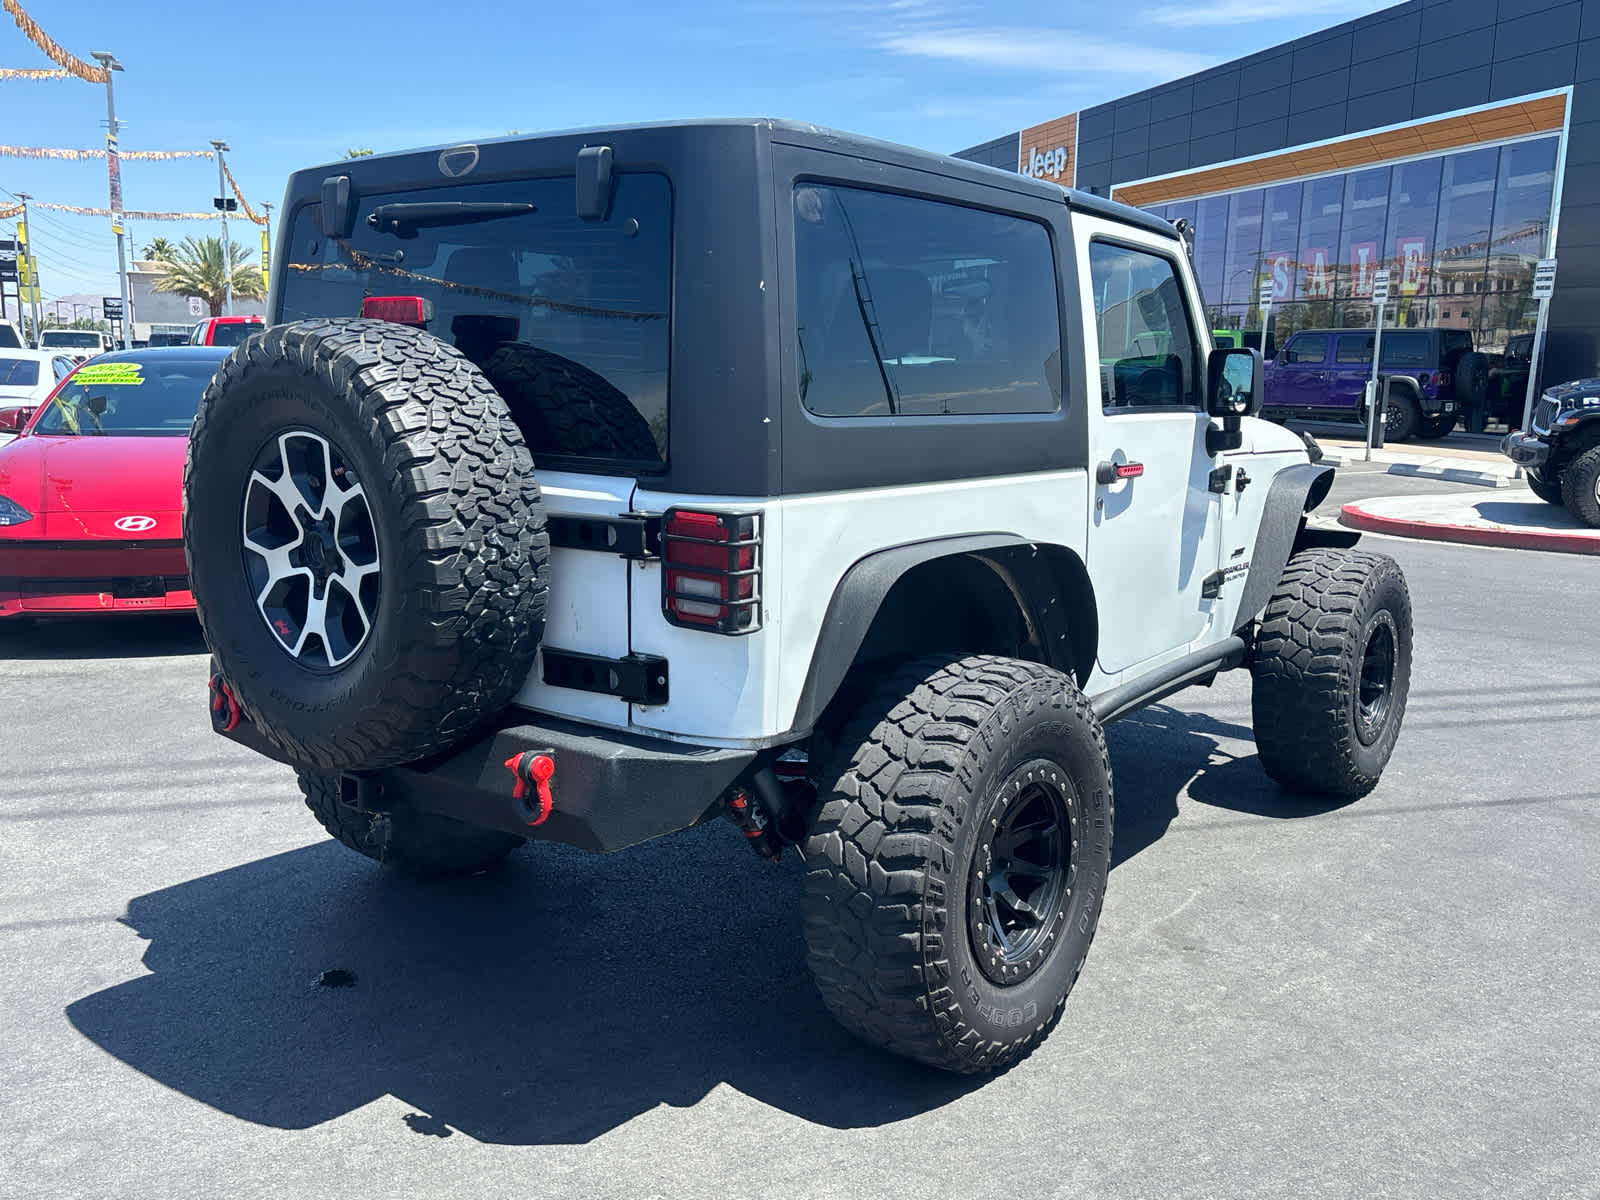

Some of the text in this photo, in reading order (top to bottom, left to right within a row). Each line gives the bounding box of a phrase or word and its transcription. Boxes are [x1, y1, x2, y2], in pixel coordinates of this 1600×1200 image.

[1023, 146, 1067, 179] Jeep
[1273, 242, 1424, 297] SALE
[961, 965, 1038, 1031] COOPER
